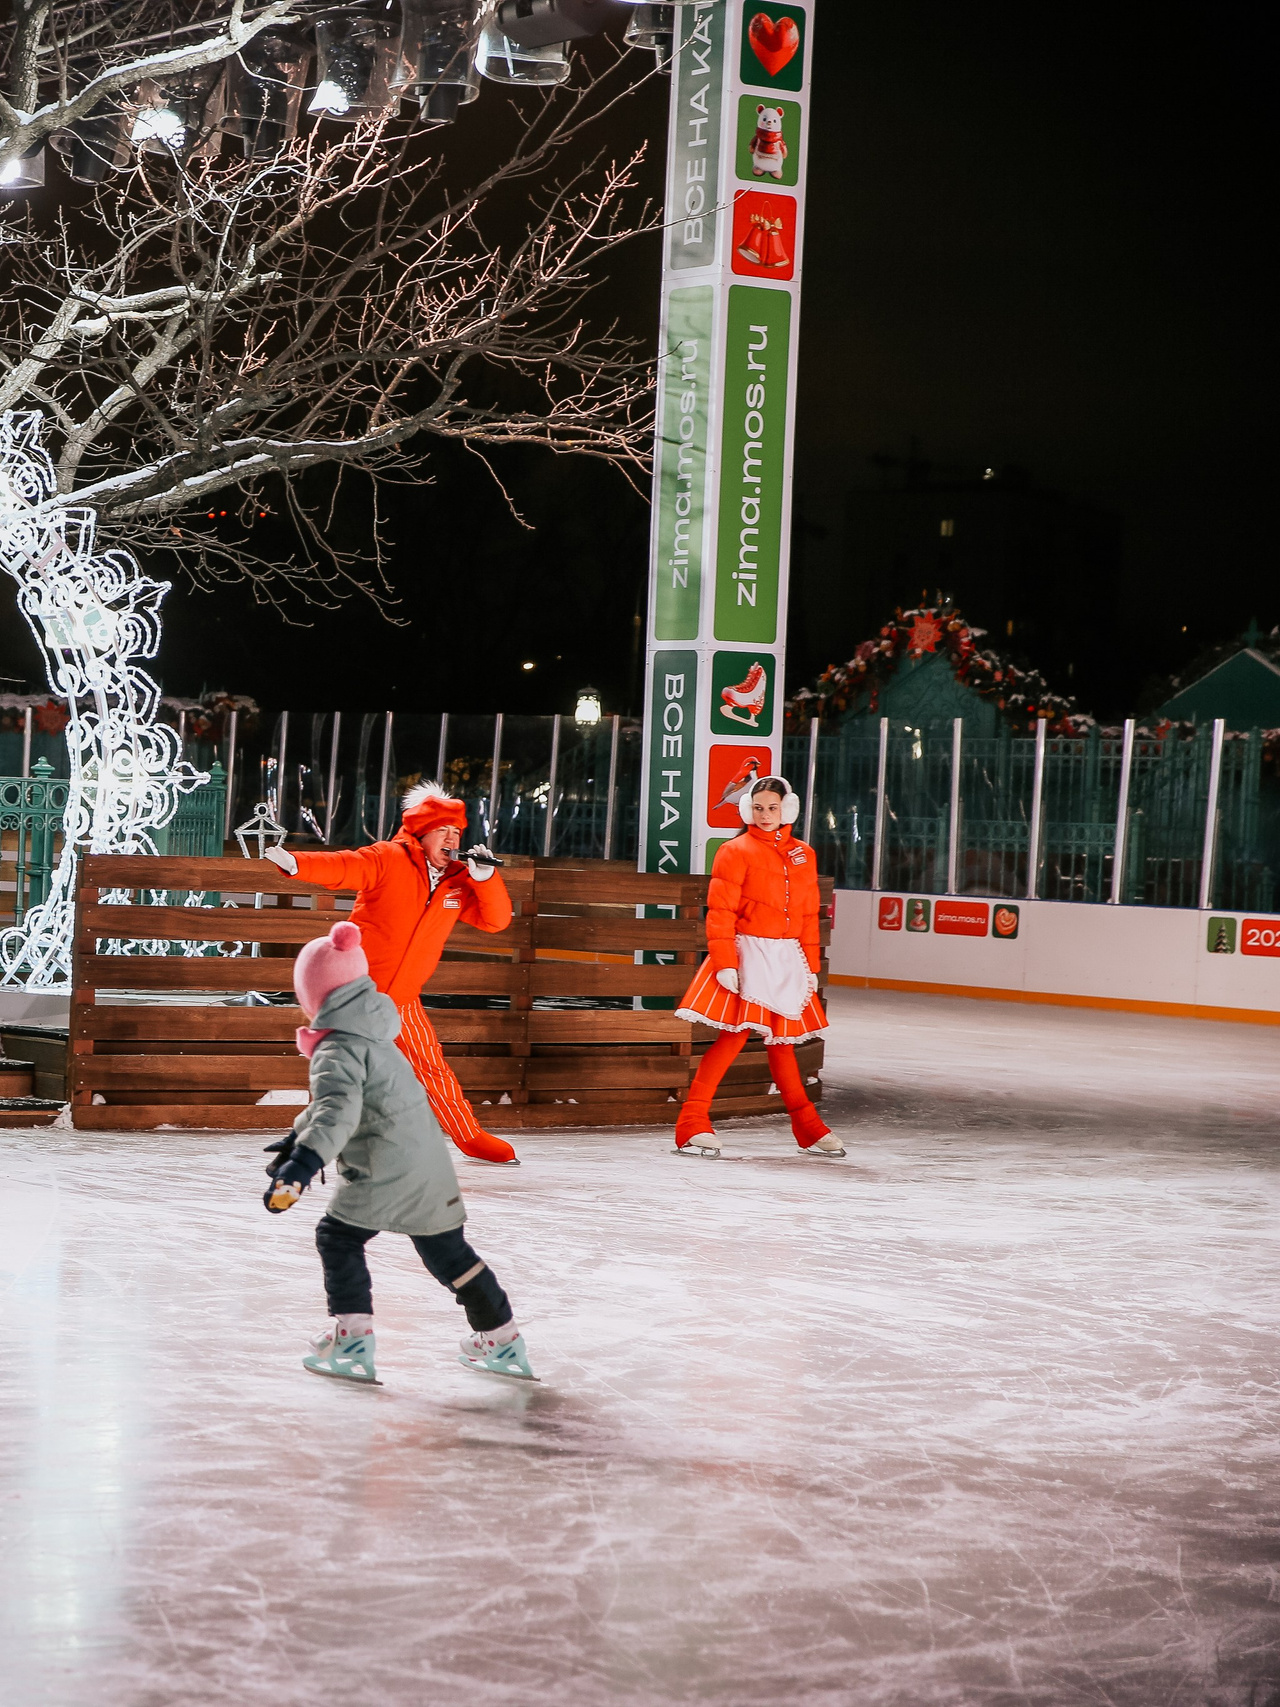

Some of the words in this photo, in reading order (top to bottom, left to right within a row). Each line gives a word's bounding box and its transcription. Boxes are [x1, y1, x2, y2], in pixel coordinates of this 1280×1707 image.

[688, 83, 711, 148] НА
[683, 157, 707, 246] ВСЕ
[668, 339, 698, 589] zima.mos.ru
[732, 324, 768, 607] zima.mos.ru
[662, 673, 685, 758] ВСЕ
[659, 770, 682, 830] НА
[937, 912, 986, 925] zima.mos.ru
